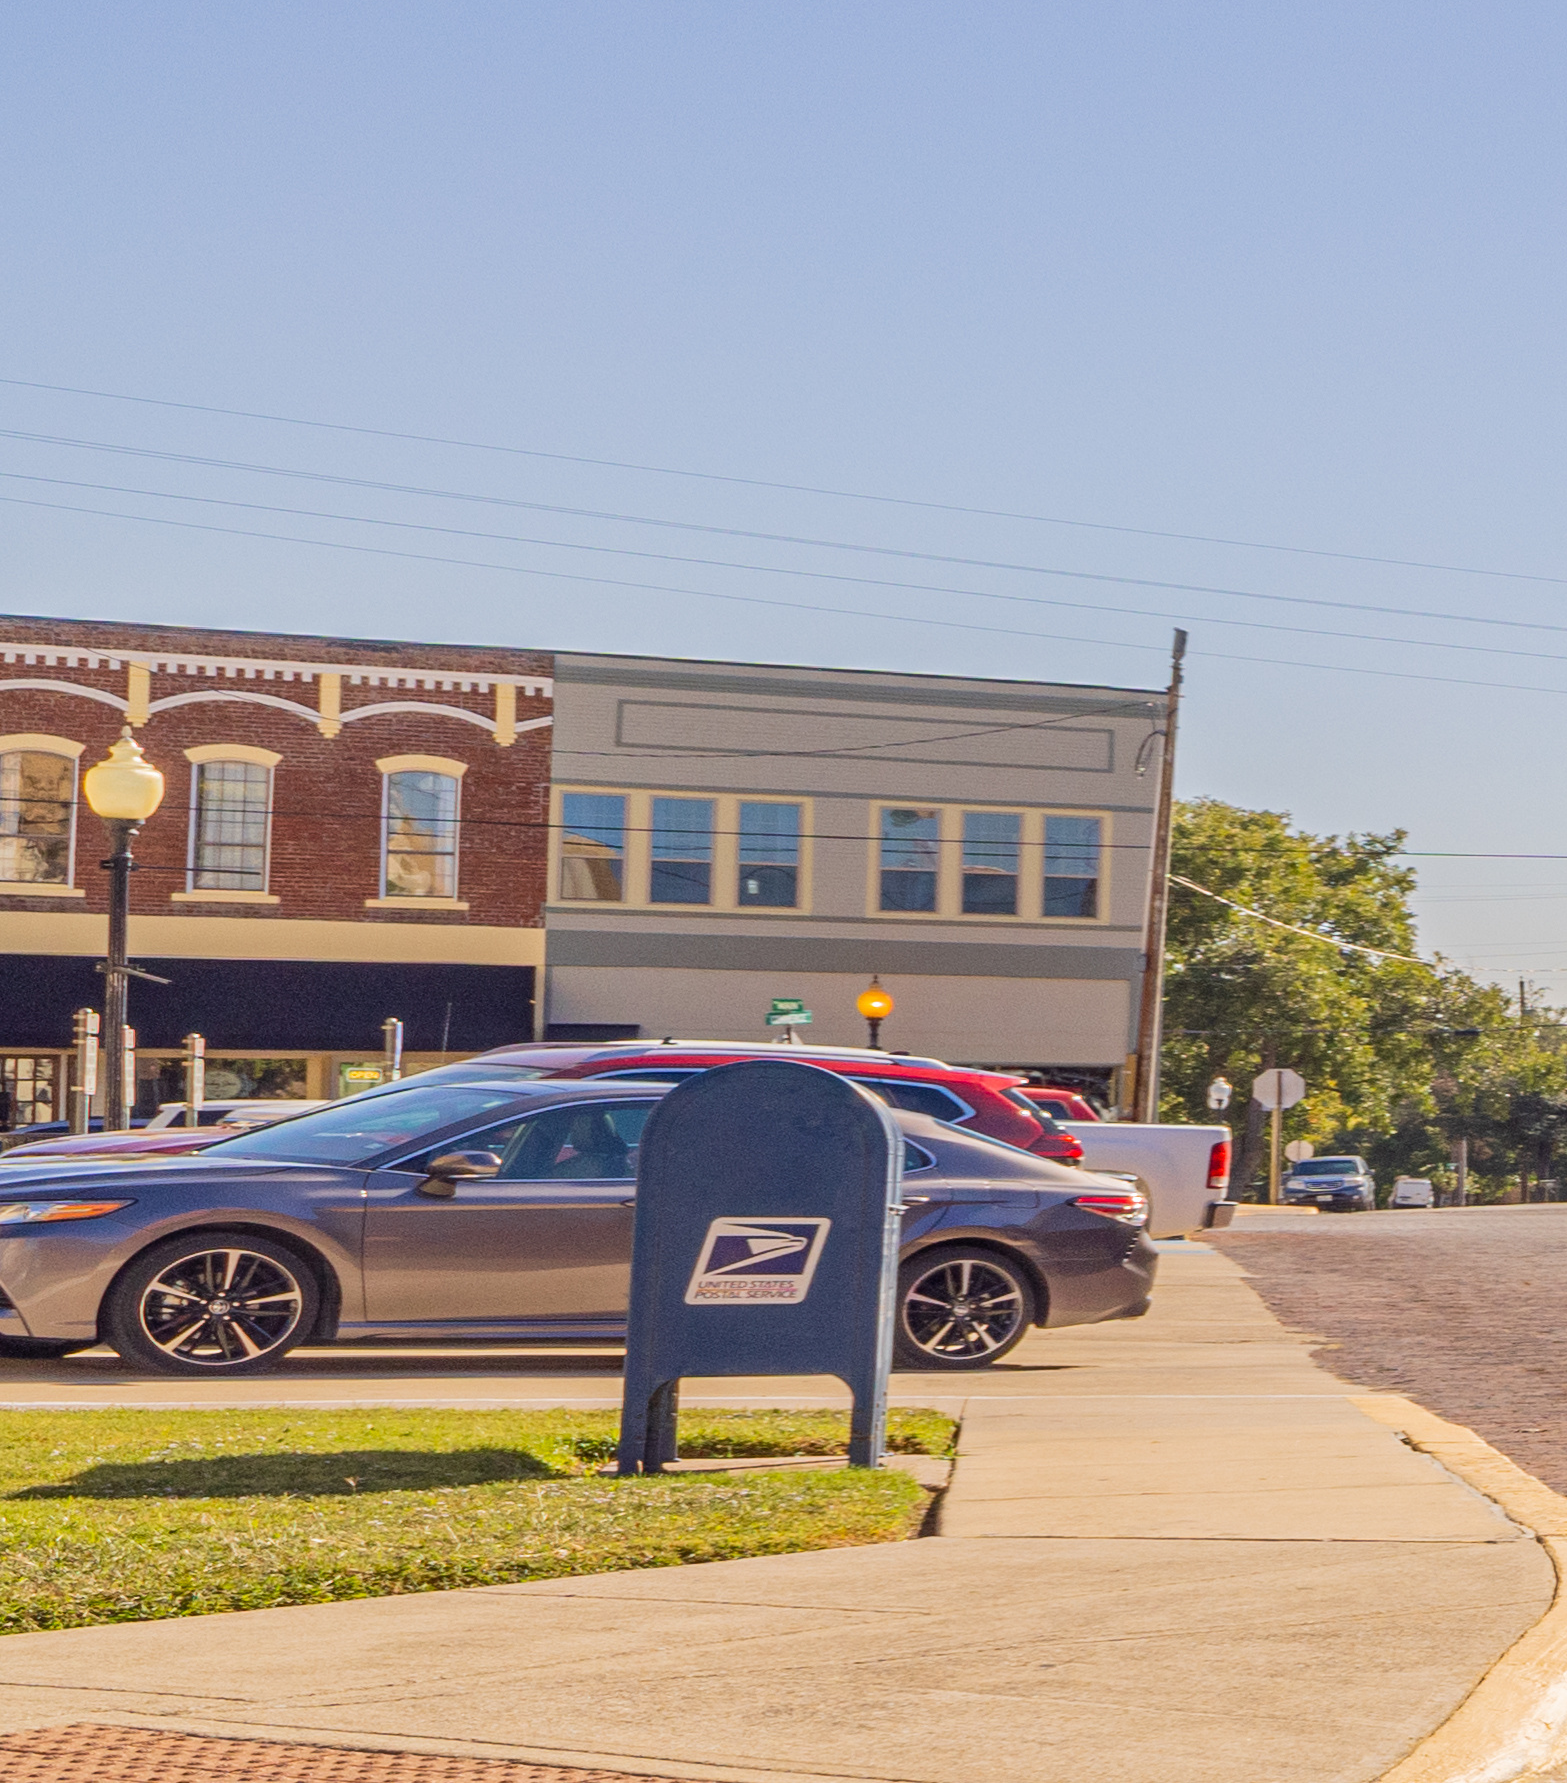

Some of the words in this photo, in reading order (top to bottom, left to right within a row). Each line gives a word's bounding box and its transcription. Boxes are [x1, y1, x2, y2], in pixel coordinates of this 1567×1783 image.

[698, 1280, 747, 1289] UNITED
[750, 1280, 795, 1289] STATES
[694, 1290, 742, 1299] POSTAL
[745, 1290, 797, 1299] SERVICE
